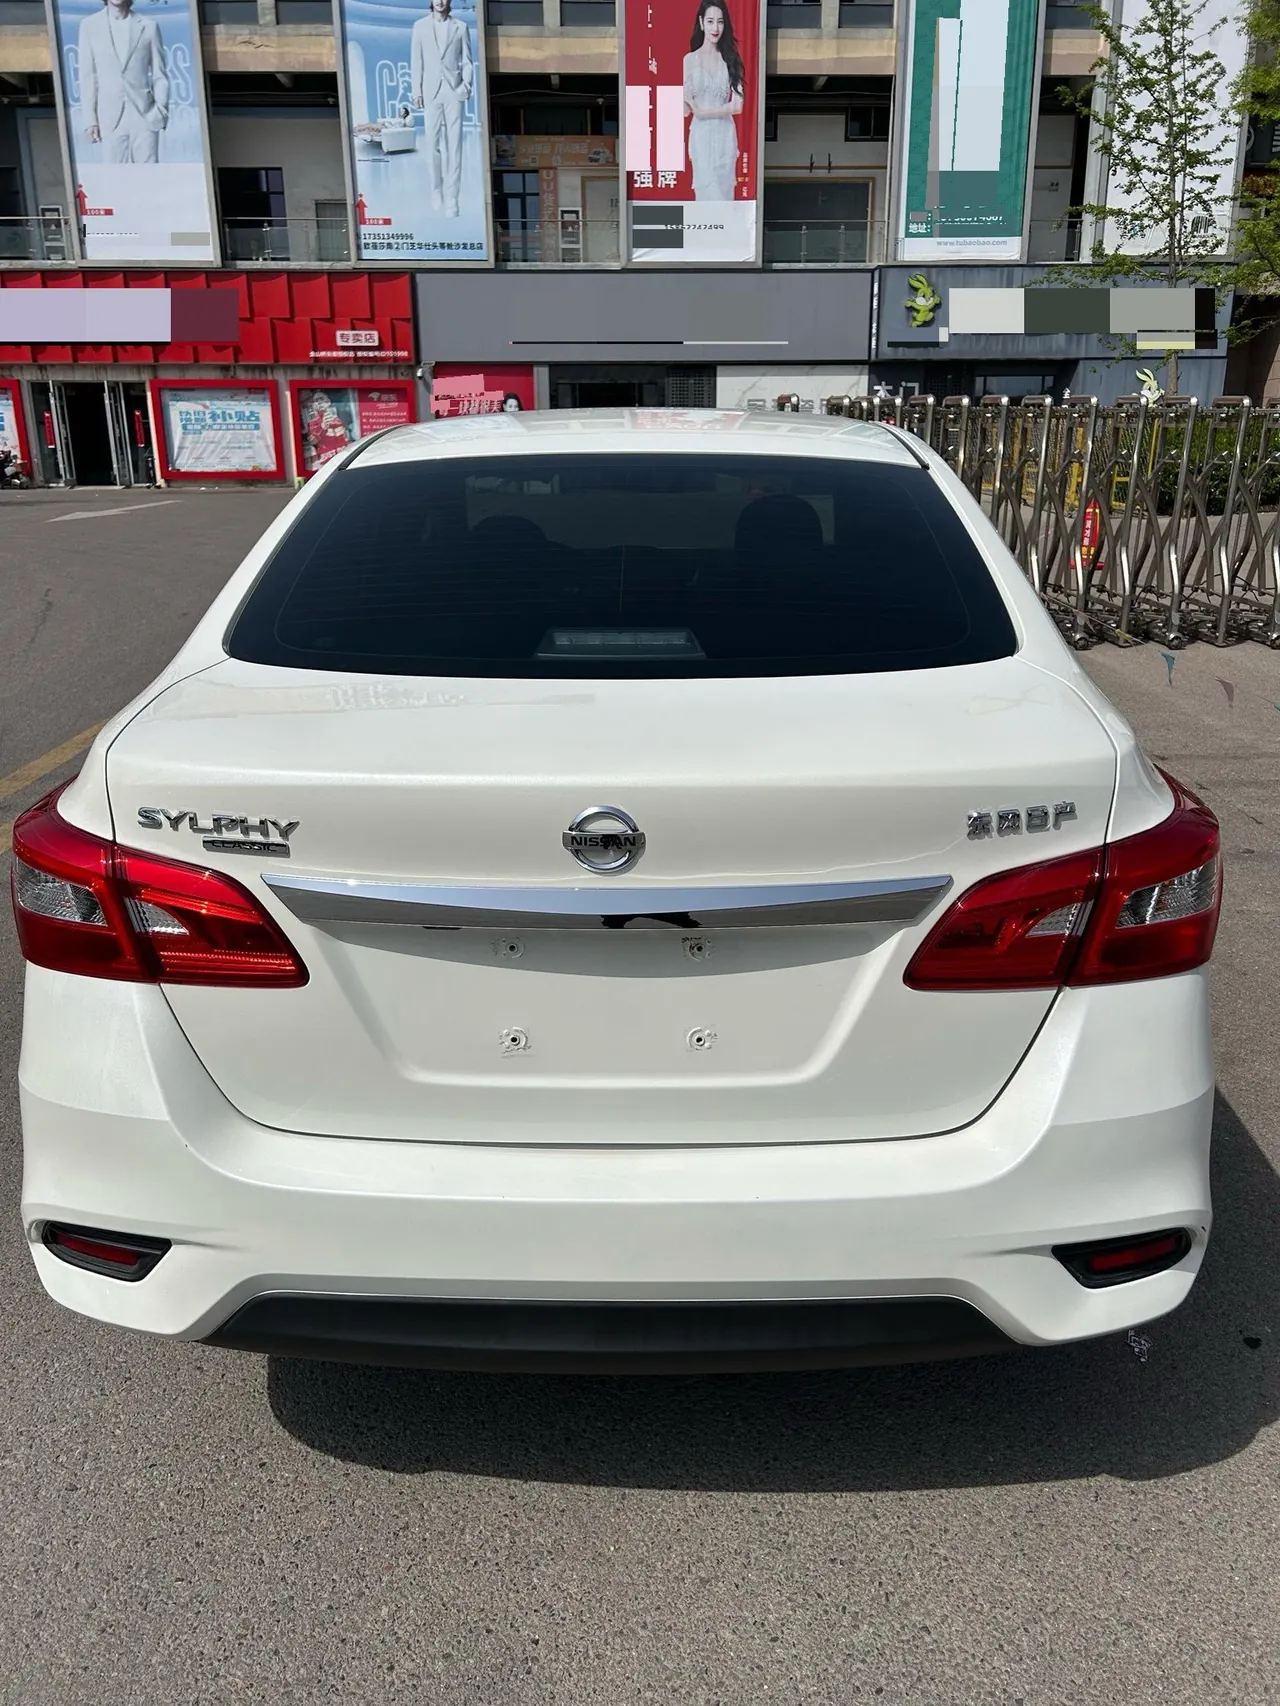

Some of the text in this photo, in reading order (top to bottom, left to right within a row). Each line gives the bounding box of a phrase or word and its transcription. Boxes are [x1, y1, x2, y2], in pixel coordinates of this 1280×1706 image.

[339, 332, 376, 344] 专卖店
[208, 410, 261, 422] 补贴
[137, 806, 301, 842] SYLPHY
[966, 800, 1078, 841] 东风日产
[211, 841, 278, 853] CLASSIC
[570, 834, 637, 850] NISSAN
